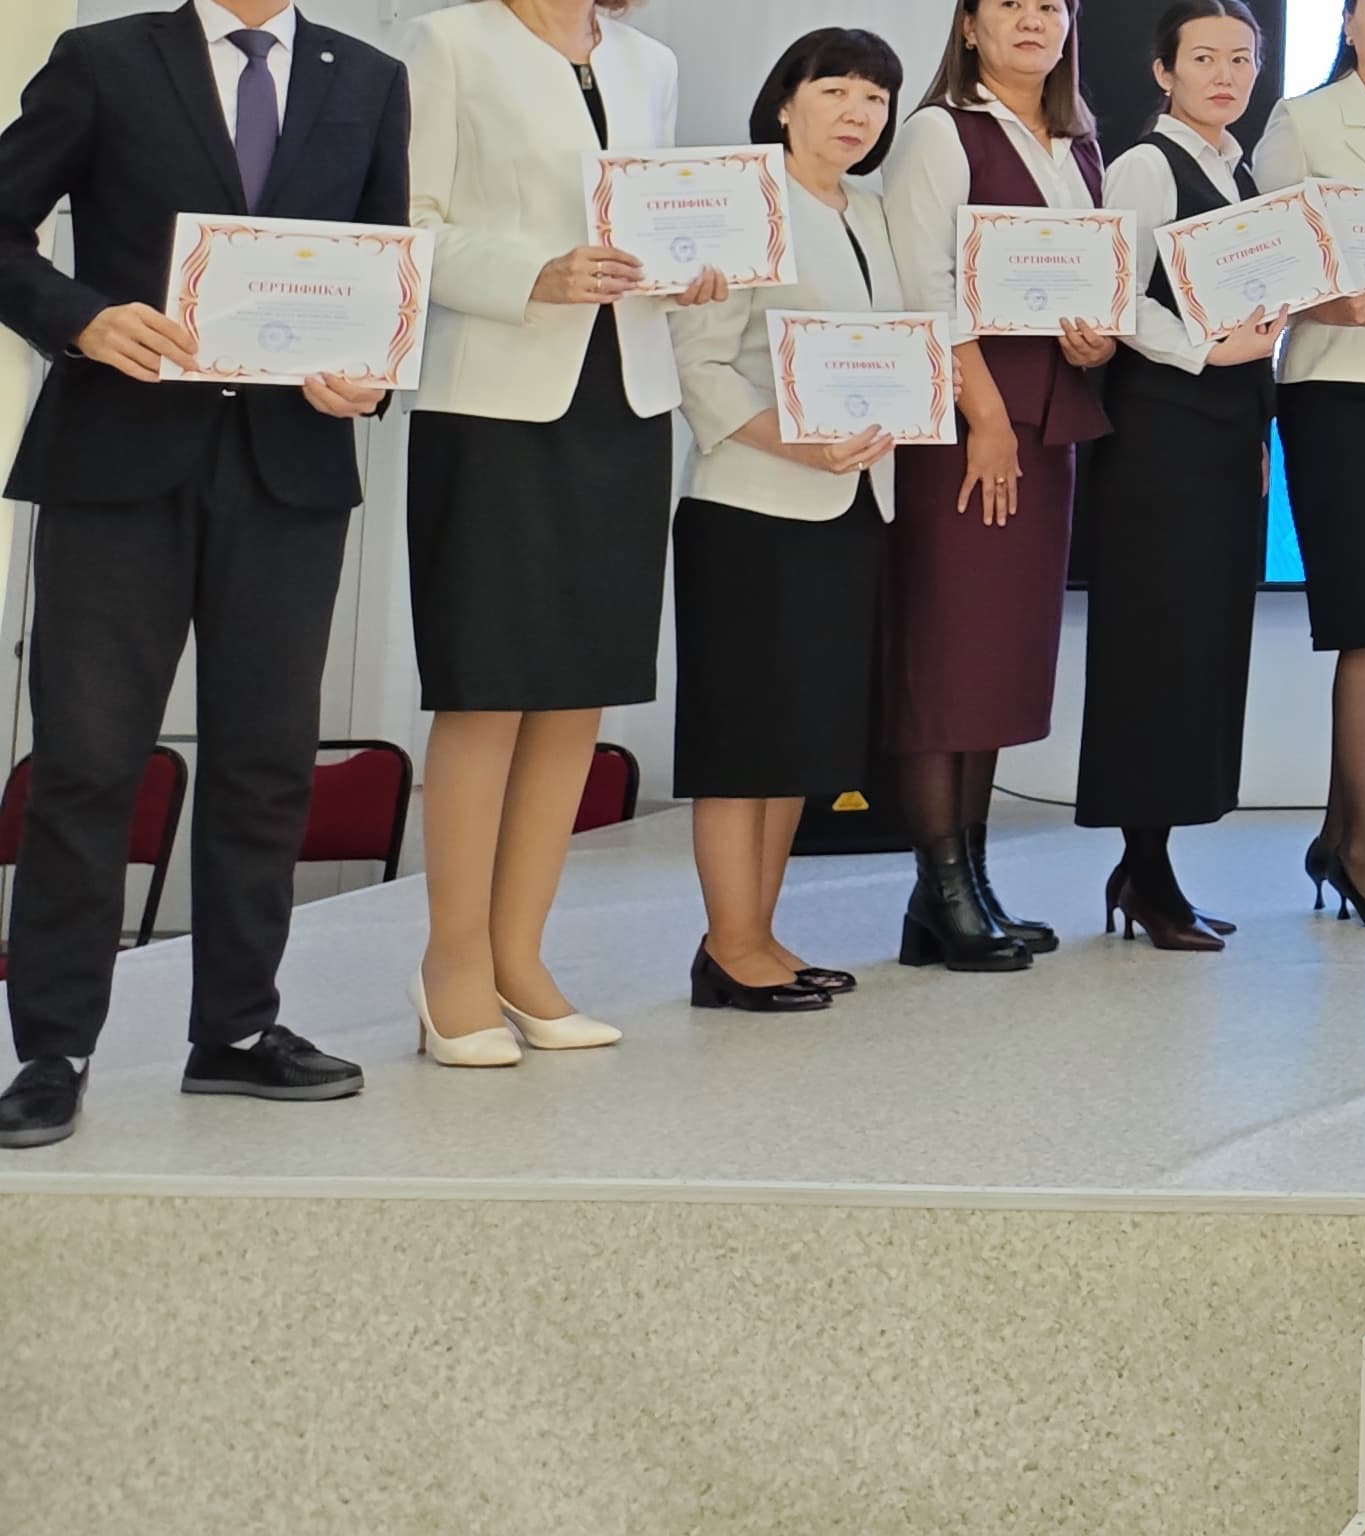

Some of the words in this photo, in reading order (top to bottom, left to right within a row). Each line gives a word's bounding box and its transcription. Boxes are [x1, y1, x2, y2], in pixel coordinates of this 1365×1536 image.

[646, 197, 729, 210] СЕРТИФИКАТ
[1215, 236, 1284, 266] СЕРТИФИКАТ
[1008, 255, 1082, 264] СЕРТИФИКАТ
[248, 280, 354, 297] СЕРТИФИКАТ
